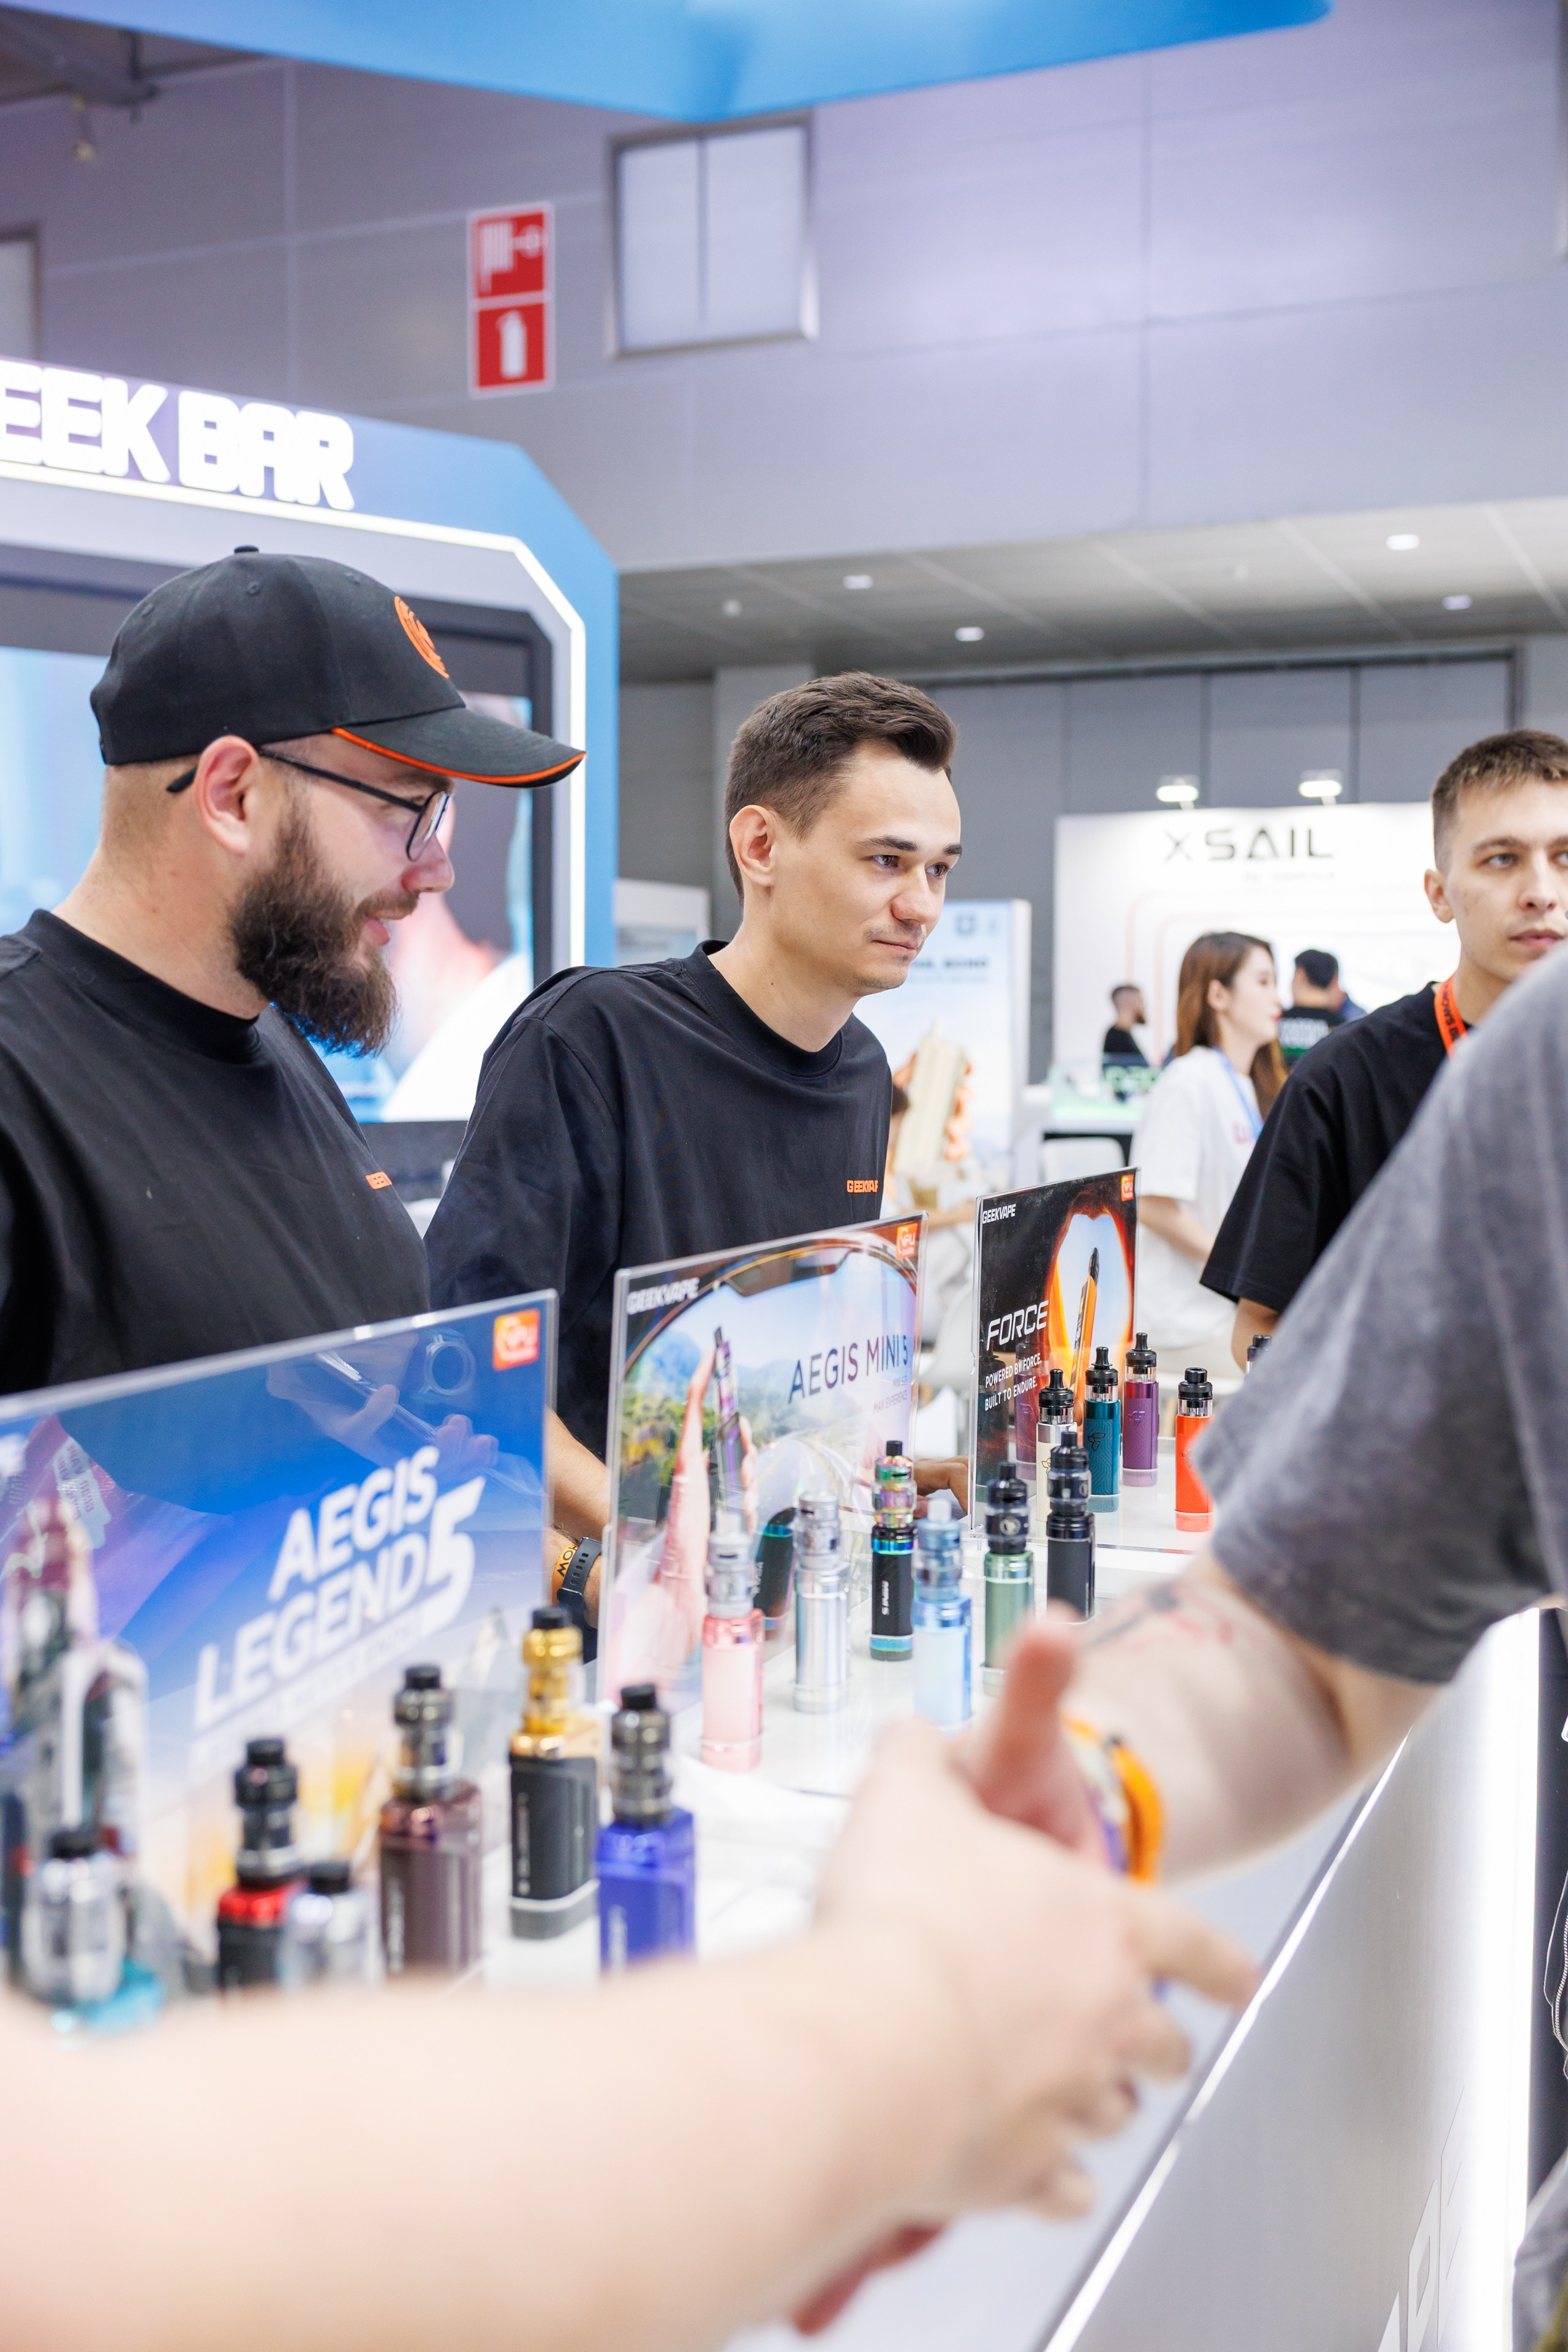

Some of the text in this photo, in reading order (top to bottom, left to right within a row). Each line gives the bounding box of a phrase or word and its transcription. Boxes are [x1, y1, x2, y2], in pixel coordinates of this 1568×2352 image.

[0, 359, 355, 511] EEK BAR
[846, 1180, 879, 1193] GEEKVAP
[982, 1204, 1016, 1224] GEEKVAPE
[627, 1277, 700, 1315] GEEKVAPE
[987, 1300, 1049, 1351] FORCE
[788, 1334, 908, 1404] AEGIS MINI 5
[986, 1352, 1042, 1389] POWERED BY FORCE.
[985, 1376, 1038, 1411] BUILT TO ENDURE.
[266, 1446, 441, 1602] AEGIS
[194, 1475, 486, 1729] LEGEND 5
